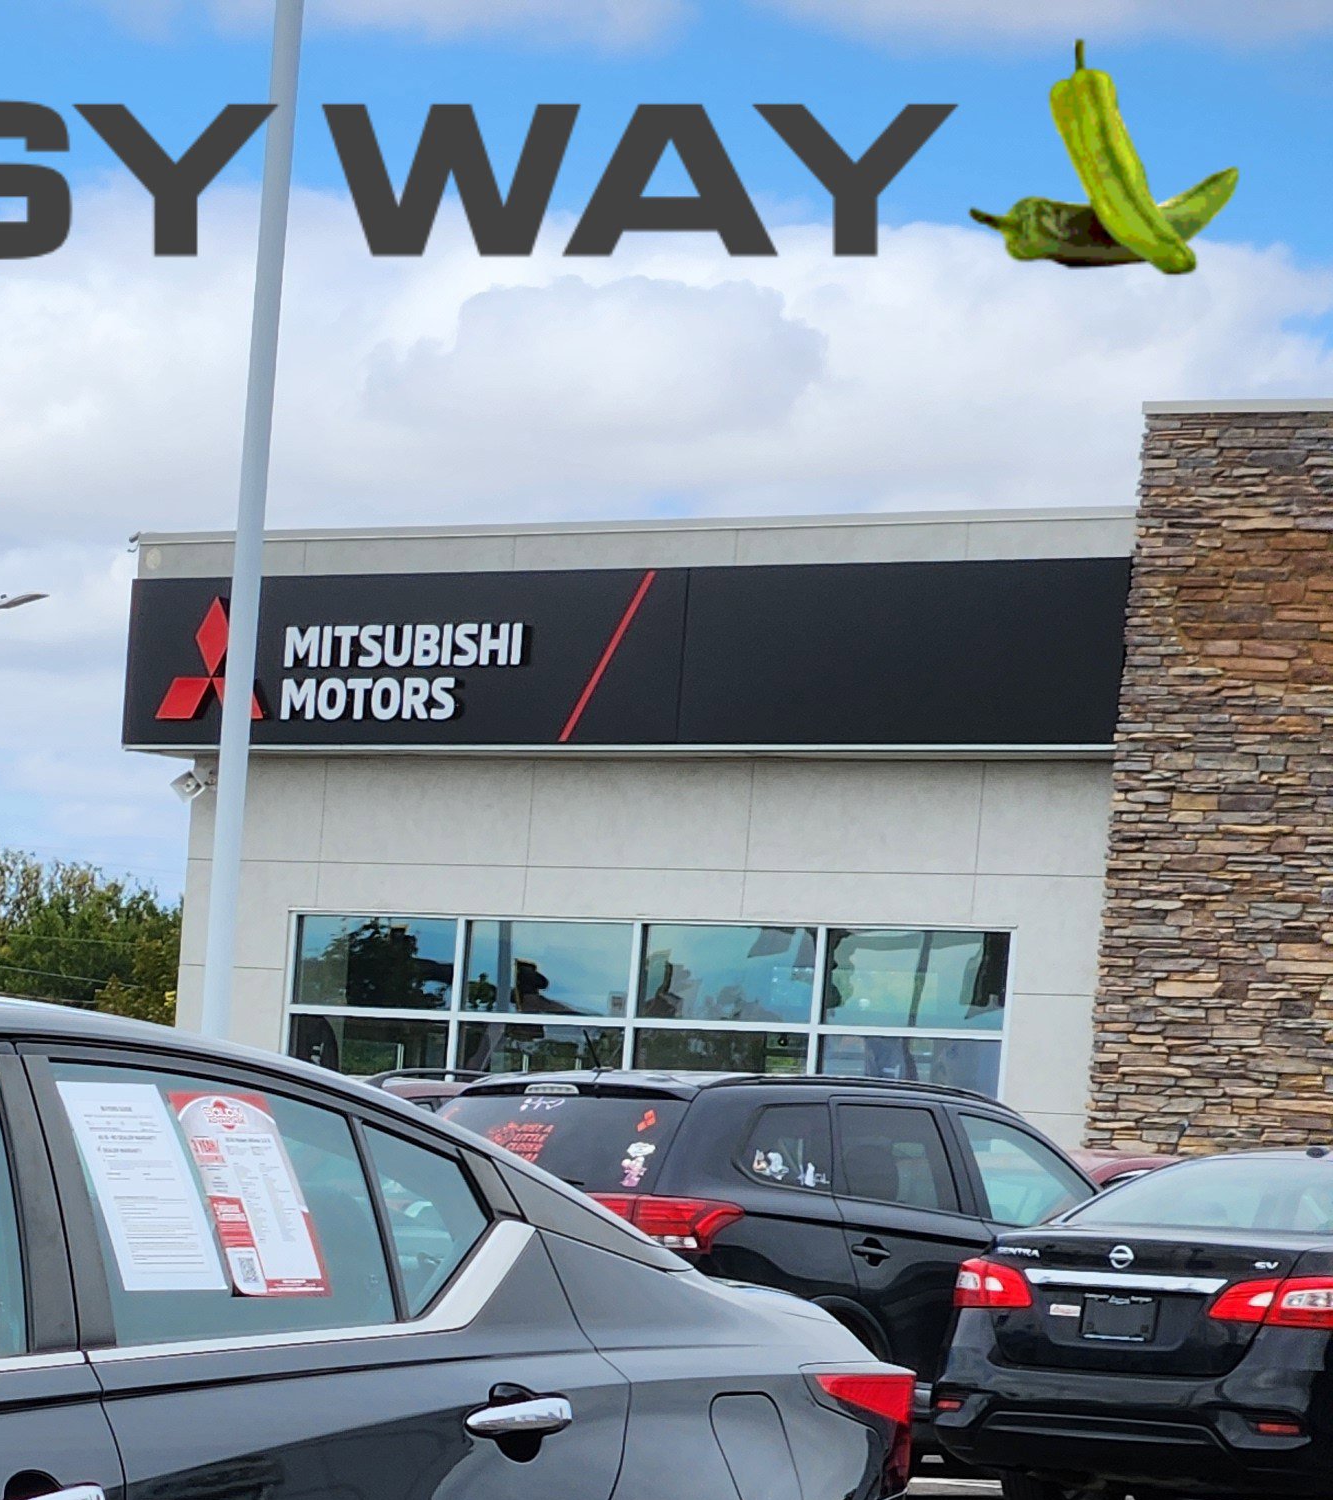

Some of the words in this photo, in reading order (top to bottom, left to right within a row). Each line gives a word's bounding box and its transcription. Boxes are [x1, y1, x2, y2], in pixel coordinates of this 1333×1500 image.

[283, 621, 524, 670] MITSUBISHI
[279, 677, 456, 721] MOTORS
[997, 1246, 1040, 1258] SENTRA
[1254, 1261, 1279, 1270] SV
